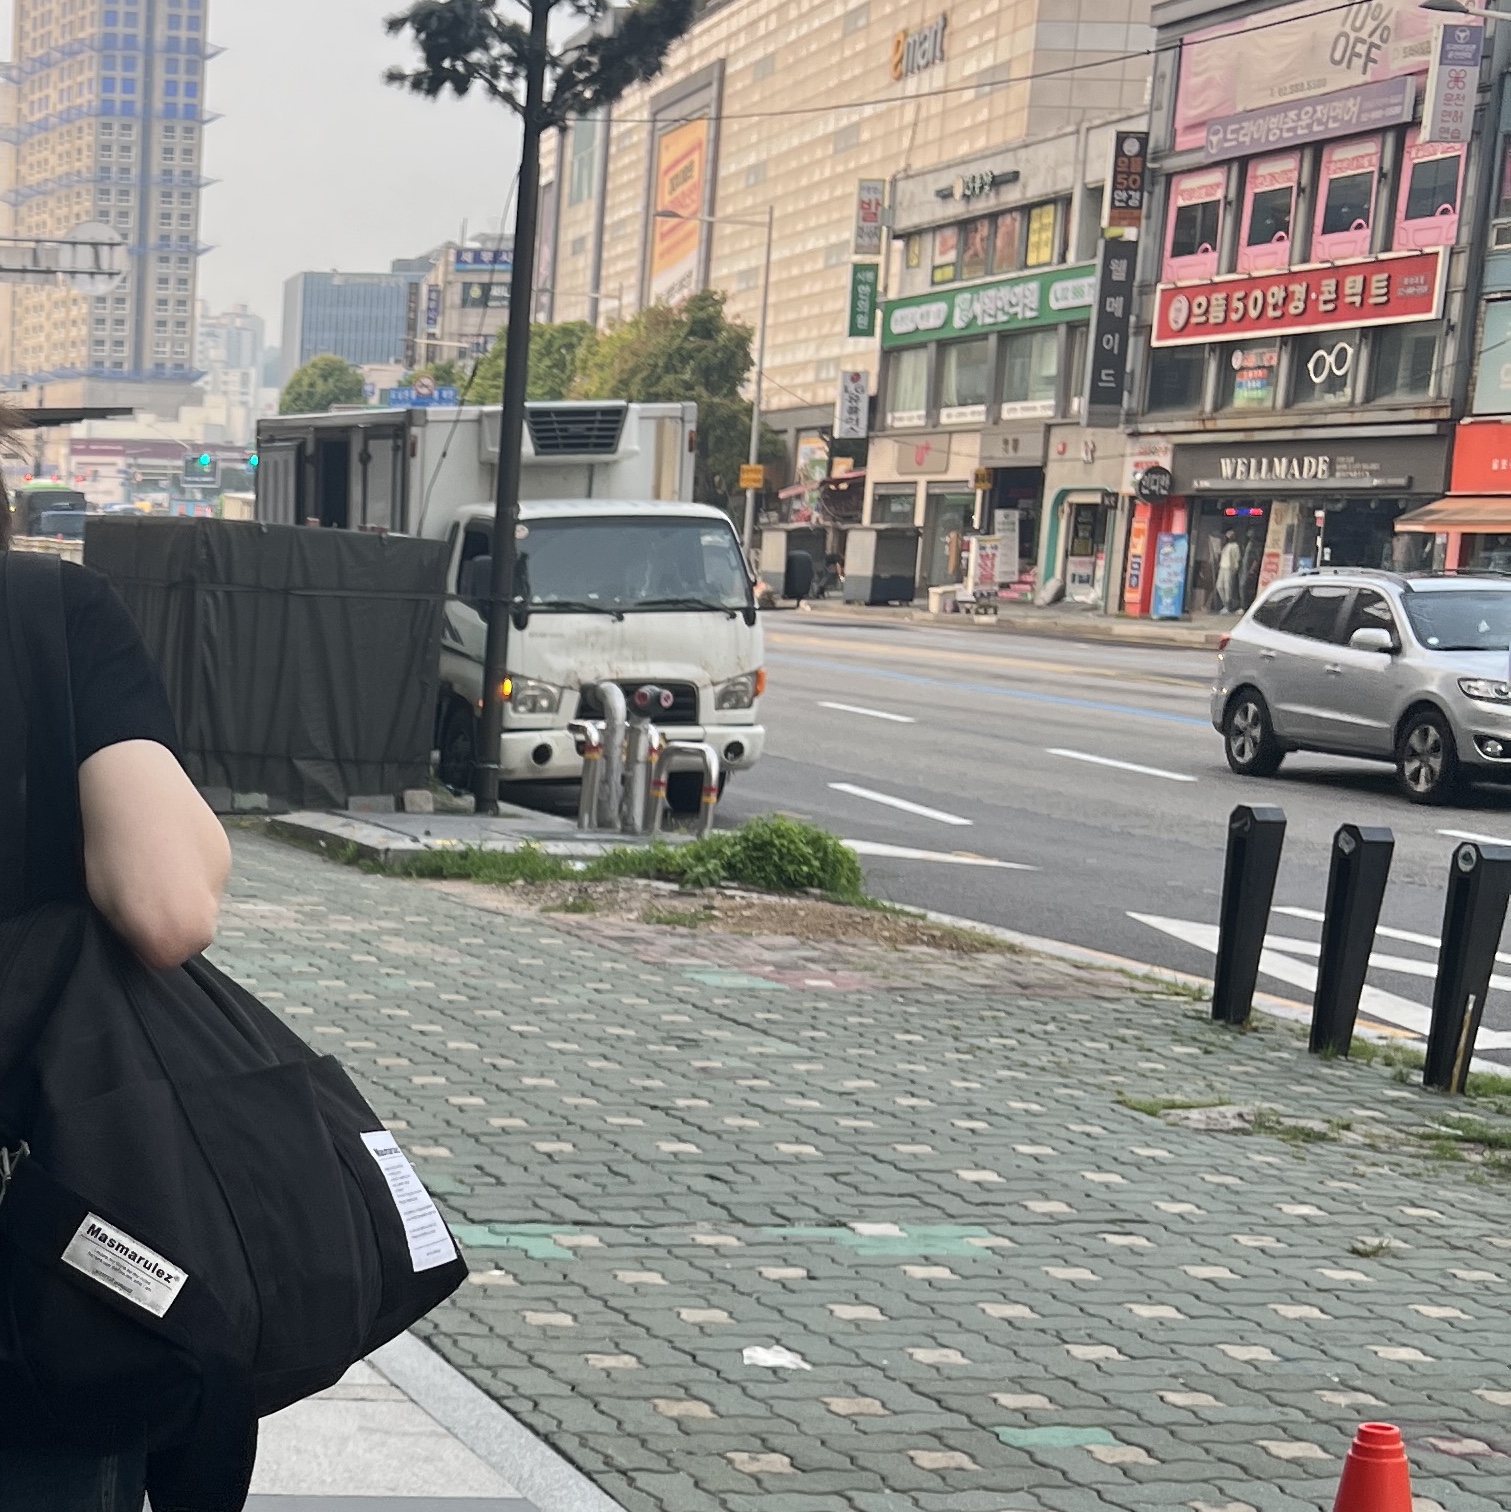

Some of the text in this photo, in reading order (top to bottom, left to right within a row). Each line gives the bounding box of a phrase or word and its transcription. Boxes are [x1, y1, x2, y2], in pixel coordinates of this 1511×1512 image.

[891, 13, 949, 81] emart
[1330, 31, 1382, 75] OFF
[1114, 190, 1141, 208] 안경
[1115, 173, 1141, 190] 50
[1098, 258, 1128, 388] 웰메이드
[1219, 456, 1330, 480] WELLMADE
[86, 1223, 174, 1284] Masmarulez
